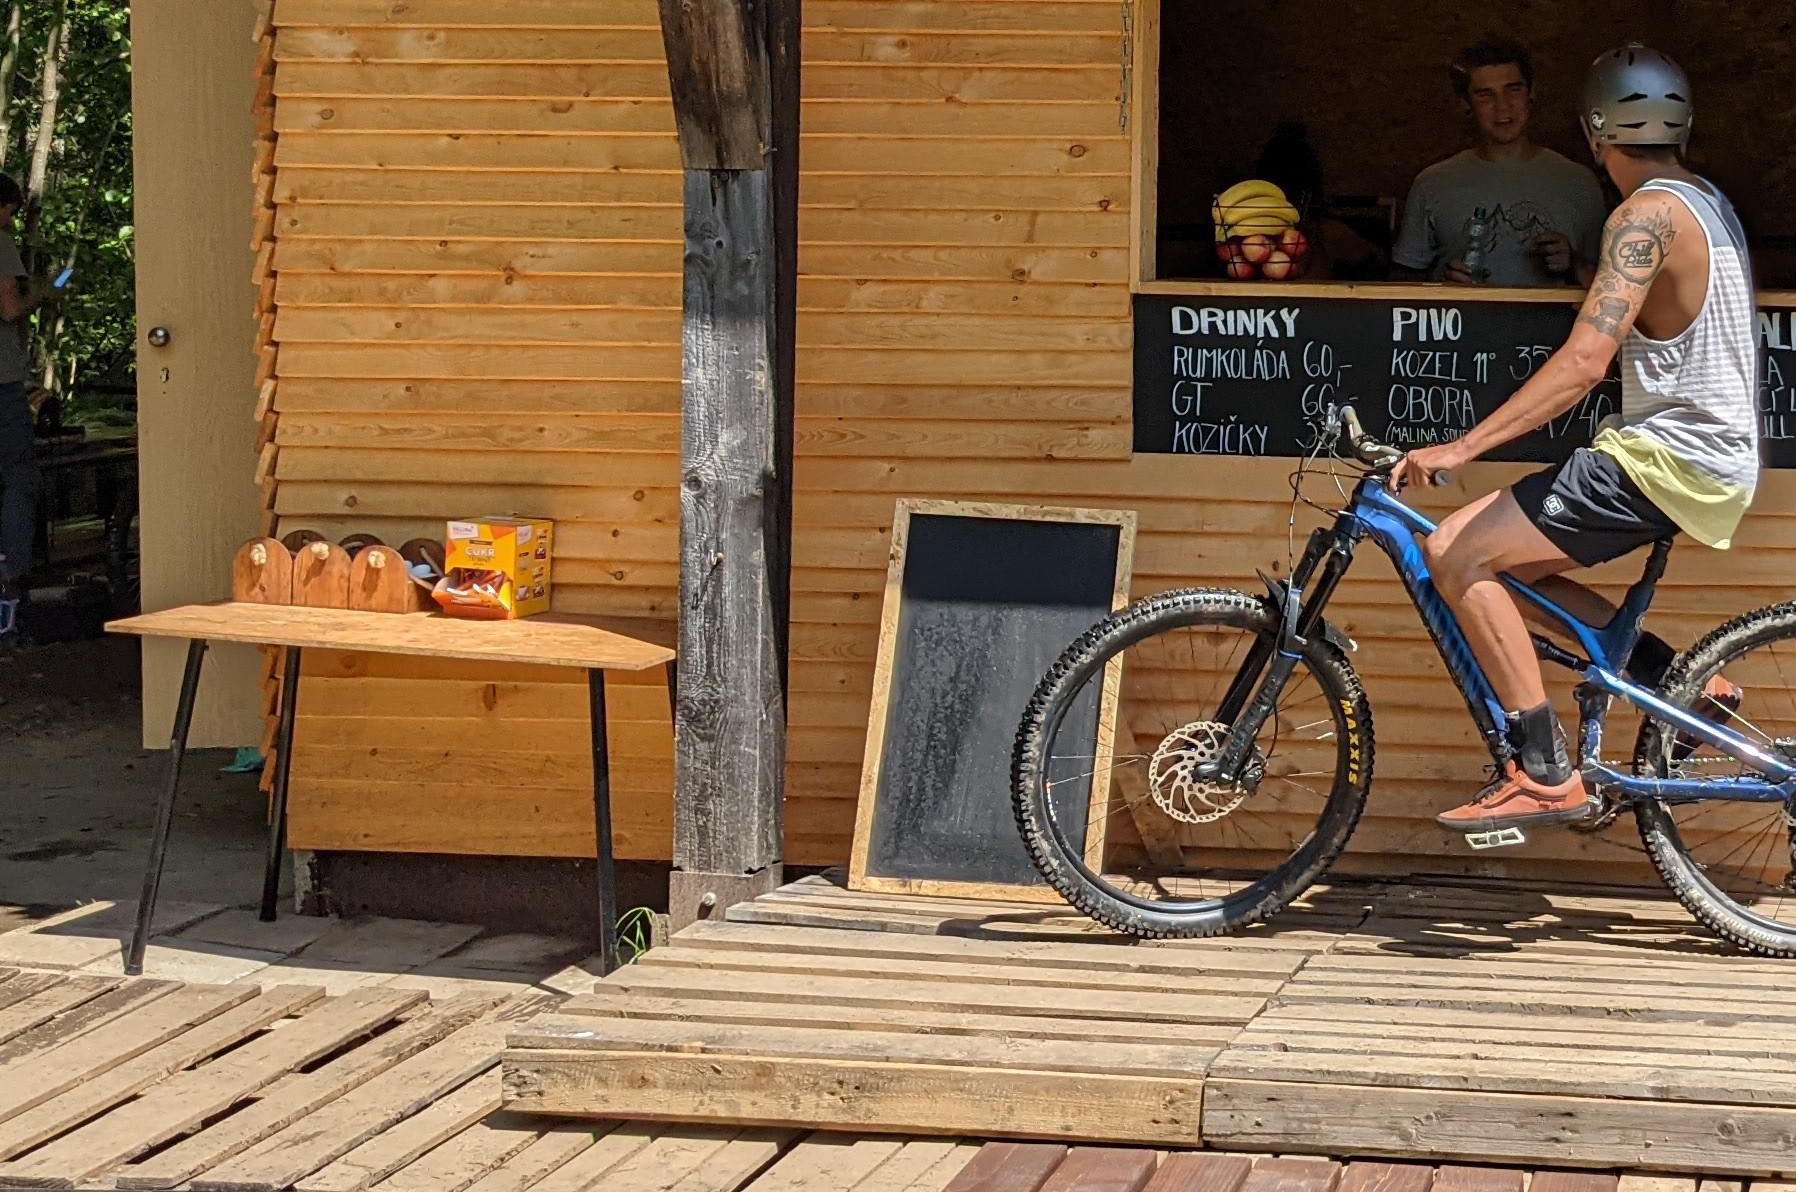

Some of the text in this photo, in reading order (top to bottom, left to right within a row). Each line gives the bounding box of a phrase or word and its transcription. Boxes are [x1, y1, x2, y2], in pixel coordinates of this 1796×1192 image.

[1171, 306, 1300, 338] DRINKY
[1392, 307, 1462, 341] PIVO
[1173, 339, 1291, 381] RUMKOLÁDA
[1391, 347, 1467, 382] KOZEL
[1171, 380, 1213, 417] GT
[1388, 384, 1477, 428] OBORA
[1339, 698, 1360, 785] MAXXIS
